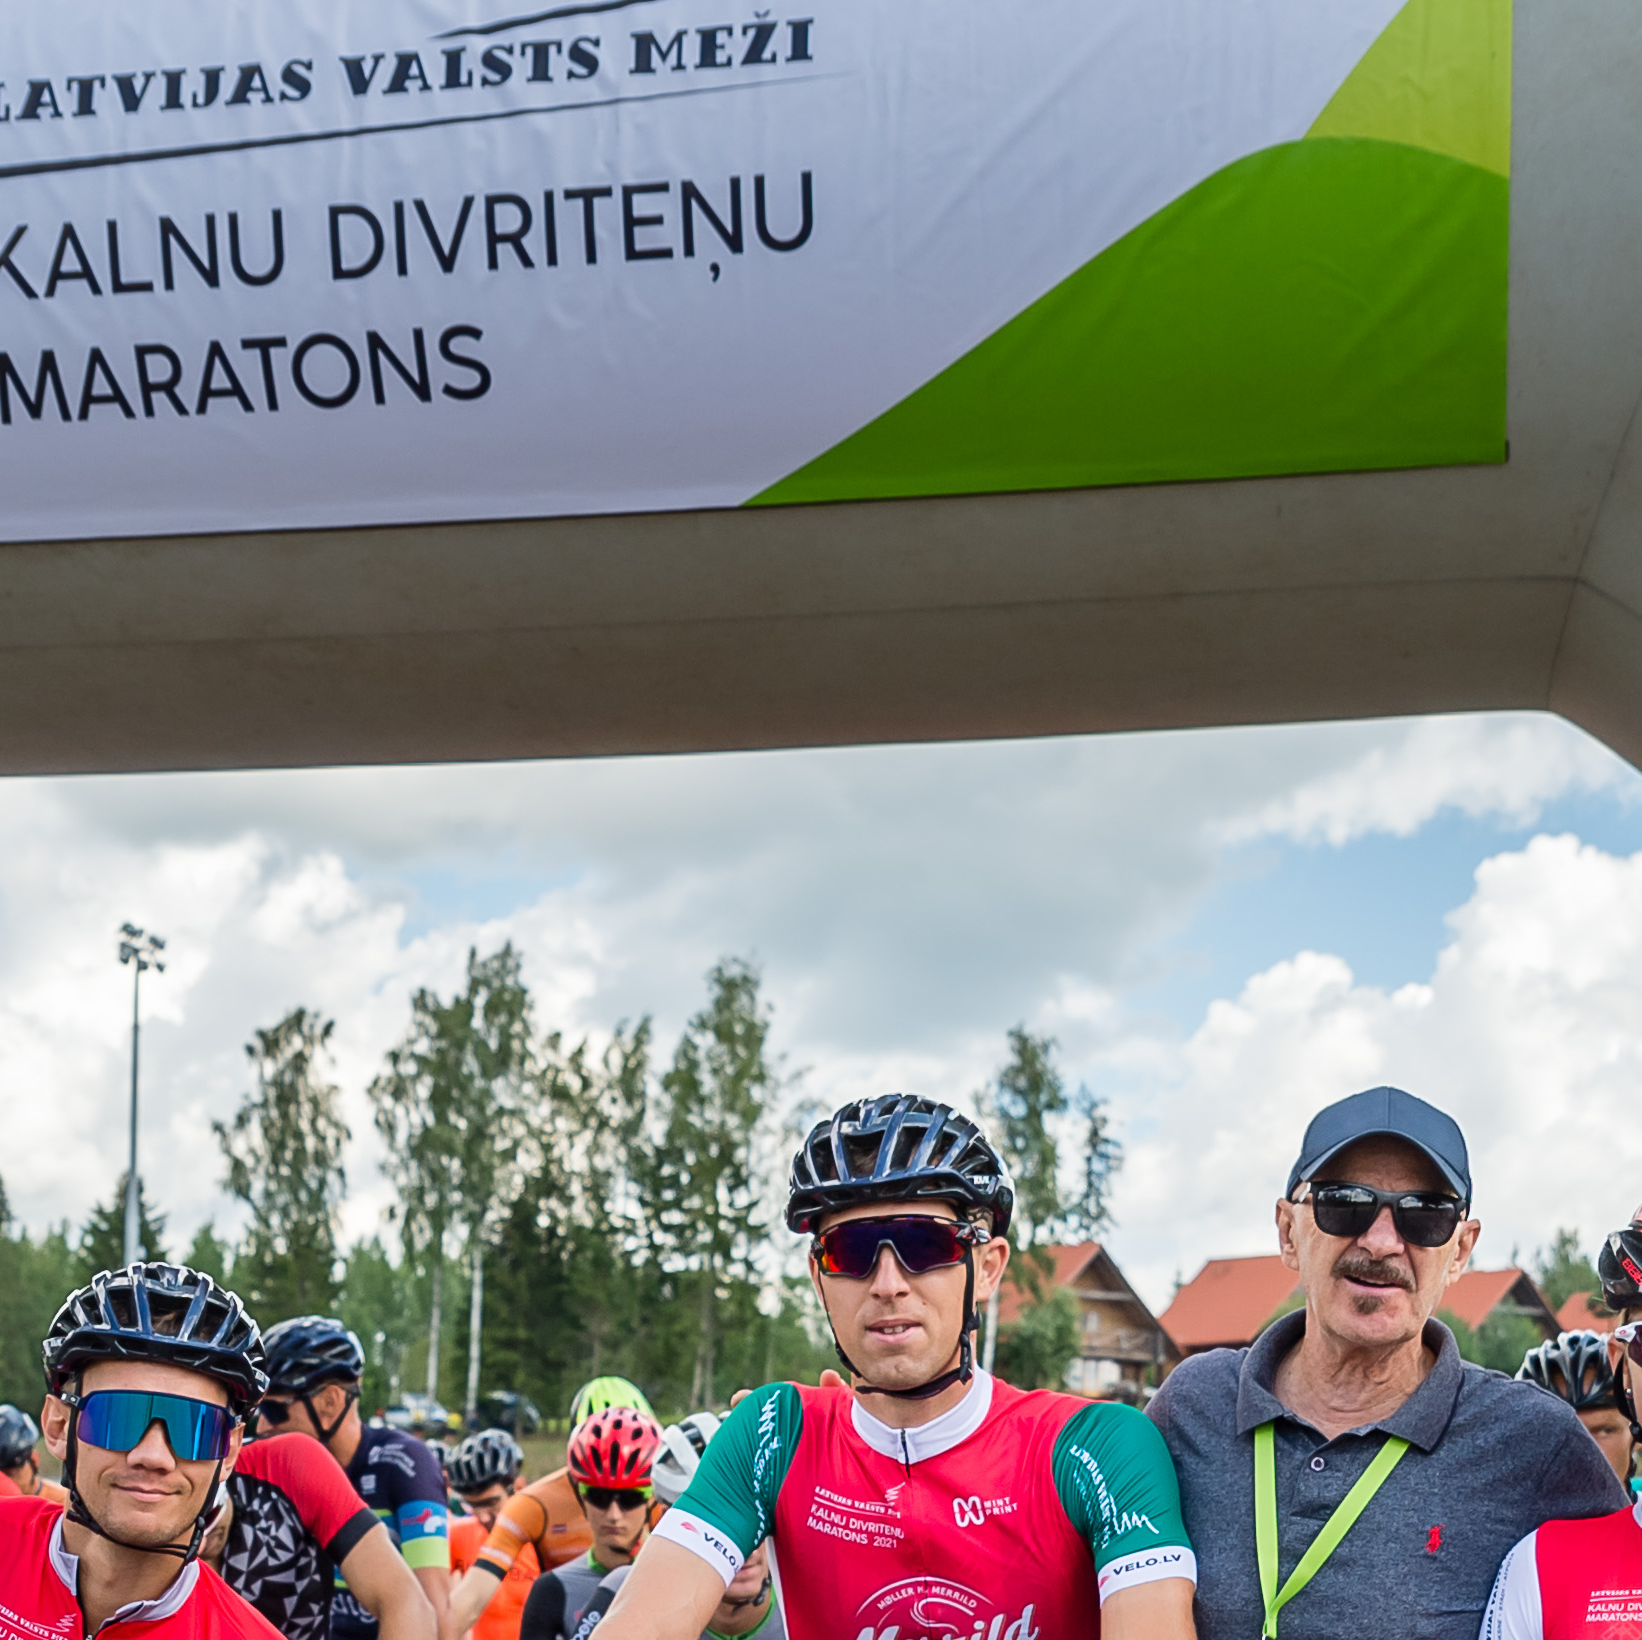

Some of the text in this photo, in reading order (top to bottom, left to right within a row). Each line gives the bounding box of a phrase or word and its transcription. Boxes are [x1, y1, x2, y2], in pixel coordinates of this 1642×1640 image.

[339, 36, 603, 97] VALSTS
[628, 8, 817, 76] MEŽI
[329, 170, 815, 282] DIVRITEŅU
[983, 1496, 1011, 1509] MINT
[985, 1502, 1019, 1517] PRINT
[810, 1503, 847, 1527] KALNU
[806, 1515, 898, 1549] MARATONS 2021
[1112, 1553, 1183, 1576] VELO.LV
[875, 1585, 916, 1610] MØLLER
[930, 1585, 978, 1609] MERRILD
[1587, 1602, 1625, 1613] KALNU
